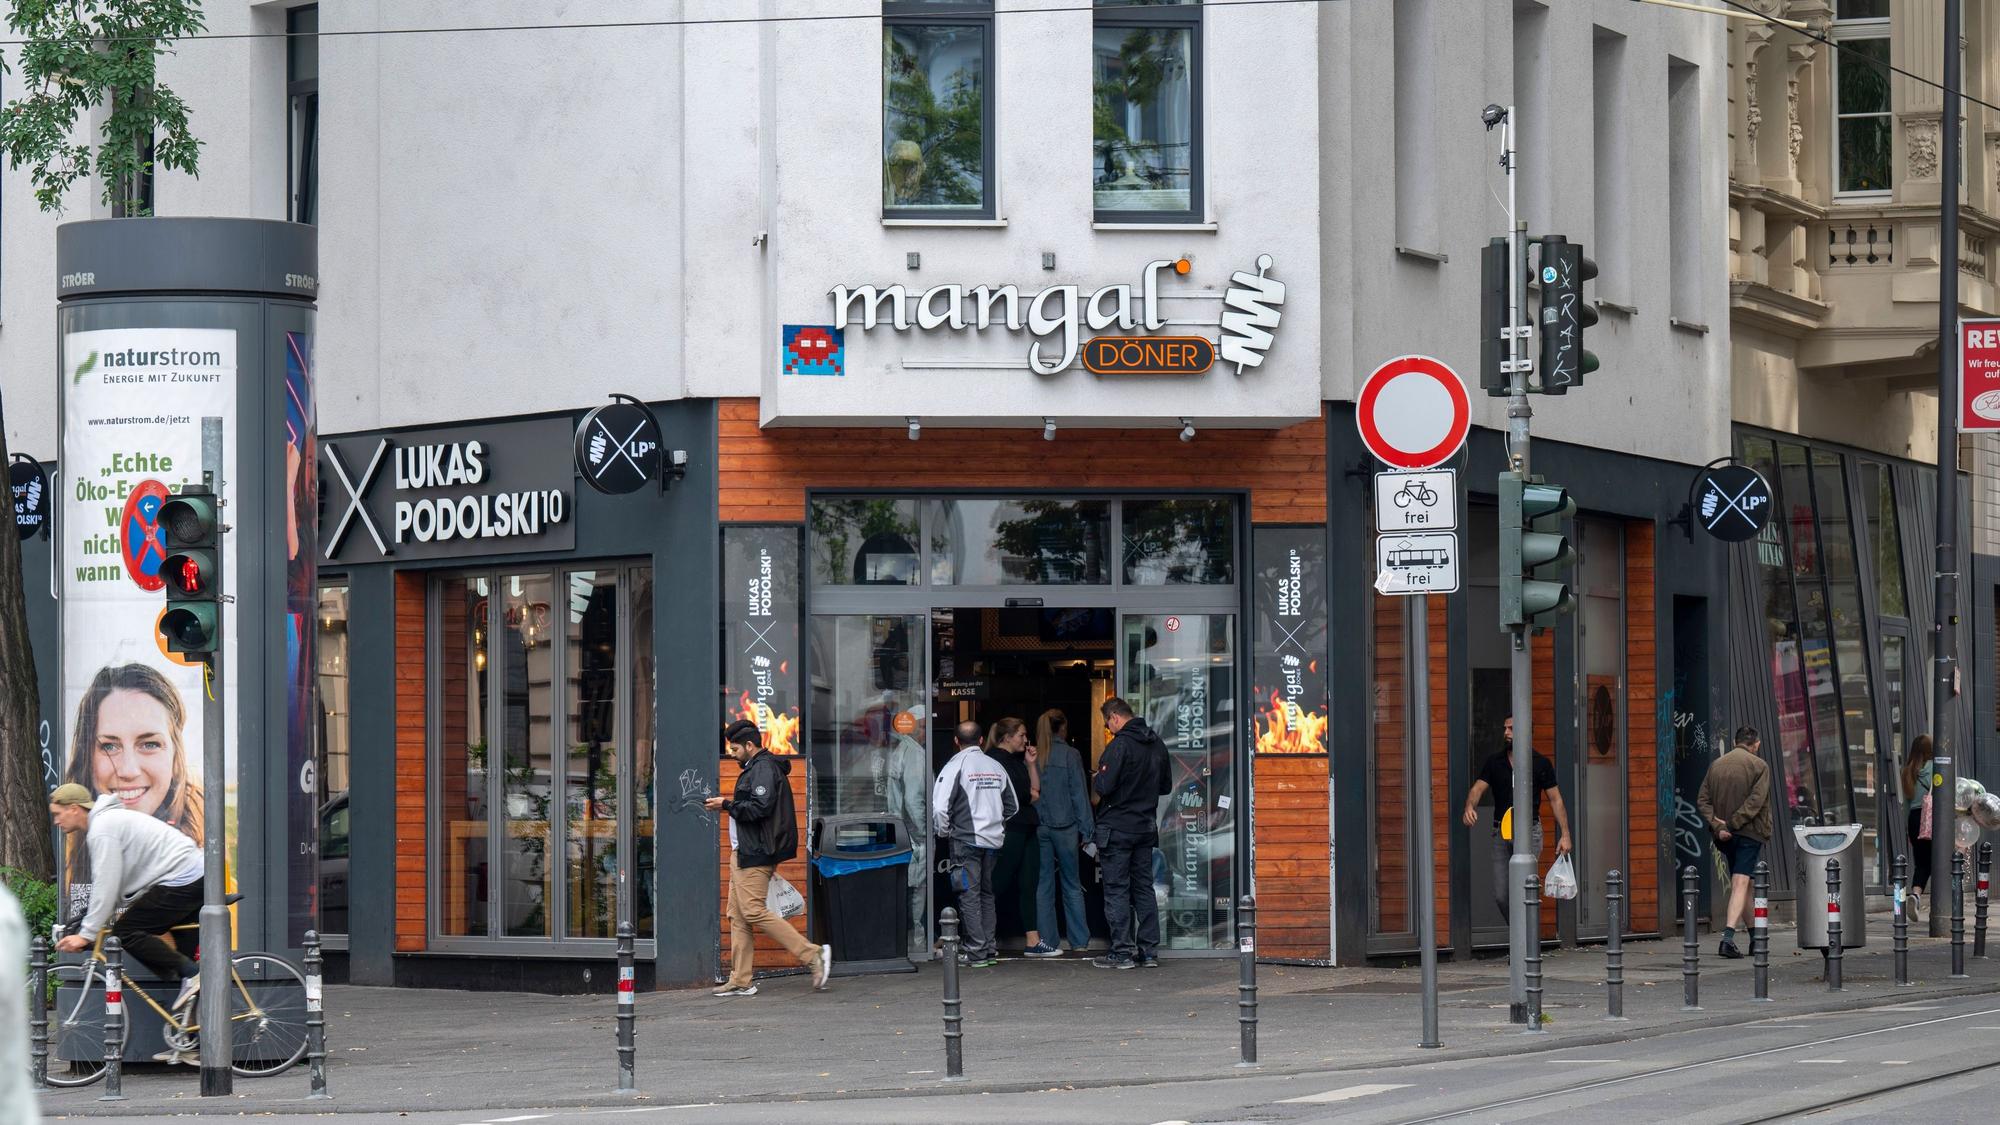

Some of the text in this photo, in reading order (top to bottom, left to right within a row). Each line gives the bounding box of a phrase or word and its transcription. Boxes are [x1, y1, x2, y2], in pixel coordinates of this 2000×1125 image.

[62, 272, 95, 288] STRÖER
[285, 273, 315, 290] STRÖER
[828, 260, 1173, 375] mangal
[103, 348, 220, 367] naturstrom
[1100, 340, 1198, 367] DÖNER
[1968, 359, 2000, 368] Wir freu
[171, 372, 221, 383] ZUKUNFT
[88, 415, 190, 426] www.naturstrom.de/jetzt
[395, 440, 484, 490] LUKAS
[1405, 511, 1429, 524] frei
[83, 533, 121, 555] nich
[76, 565, 121, 582] wann
[1406, 572, 1431, 585] frei
[749, 578, 760, 616] LUKAS
[1279, 578, 1289, 616] LUKAS
[752, 669, 775, 733] mangal
[951, 688, 976, 696] KASSE
[1282, 667, 1304, 731] mangal
[1178, 704, 1190, 749] LUKAS
[1180, 810, 1207, 892] mangal
